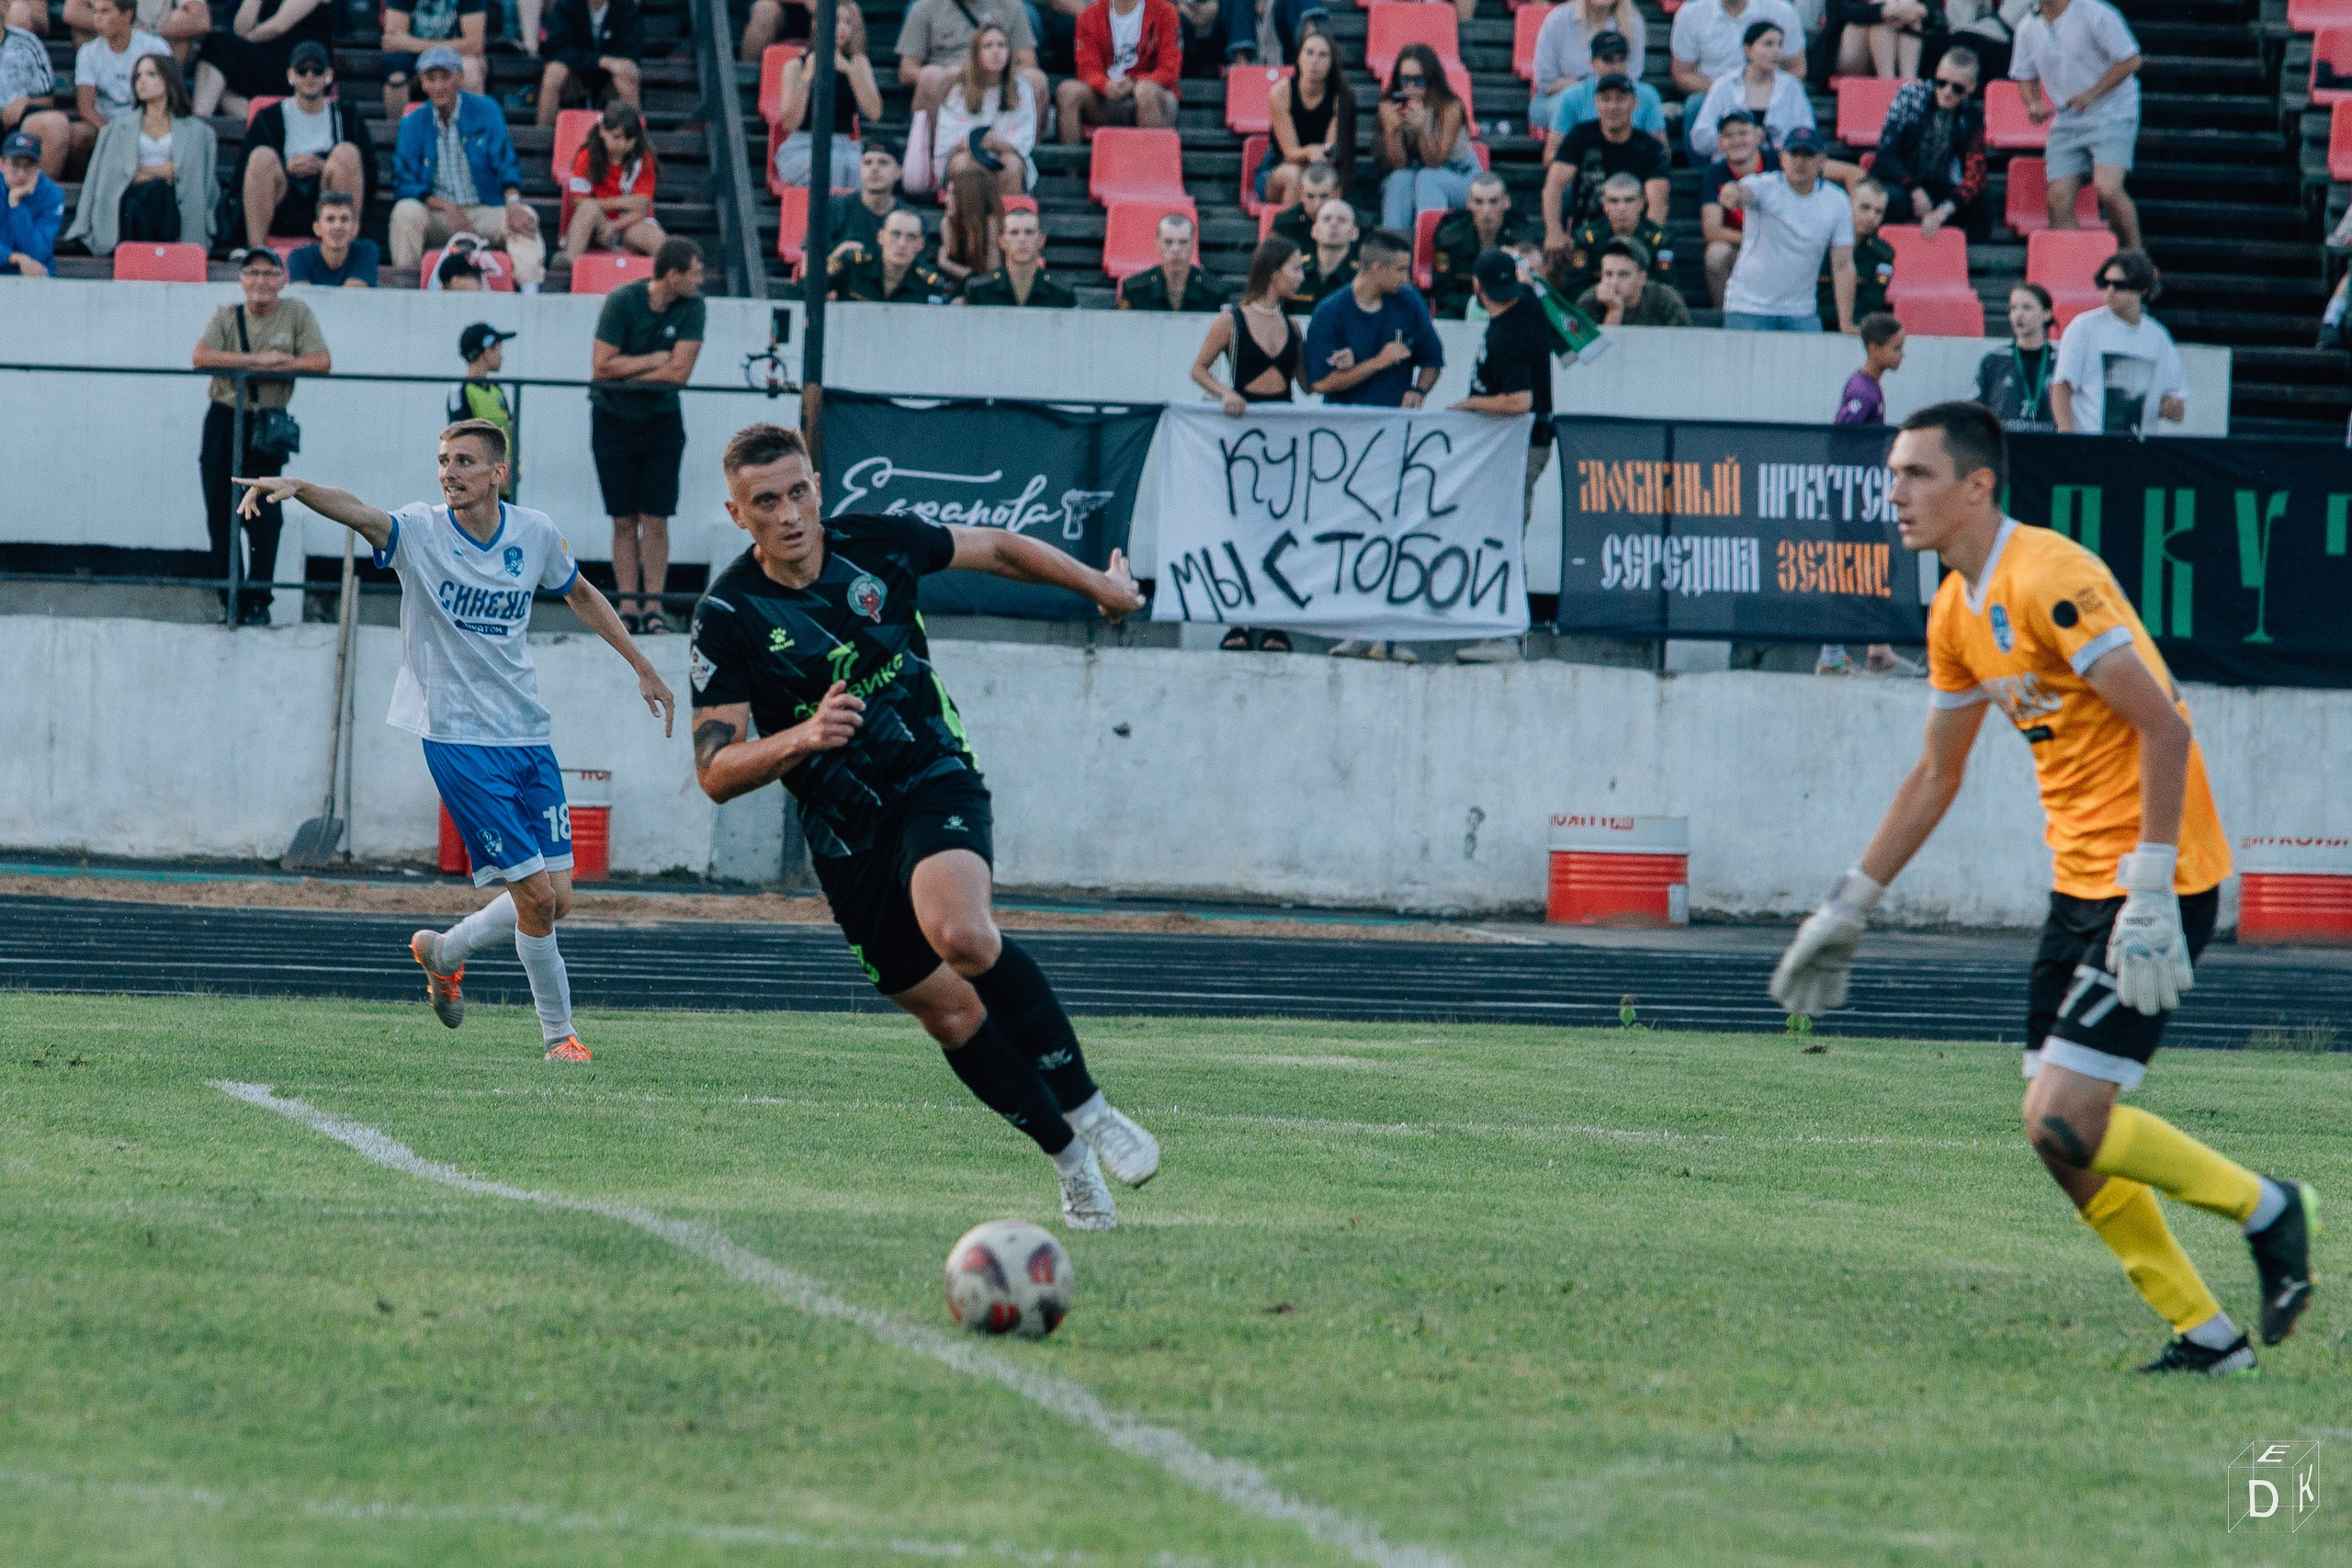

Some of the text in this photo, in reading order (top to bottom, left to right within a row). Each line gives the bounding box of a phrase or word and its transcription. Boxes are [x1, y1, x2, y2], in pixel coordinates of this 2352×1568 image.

[1219, 421, 1458, 524] КУРСК
[1170, 540, 1256, 624] МЫ
[1313, 532, 1510, 615] ТОБОЙ
[1600, 533, 1760, 598] СЕРЕДИНА
[543, 802, 571, 843] 18
